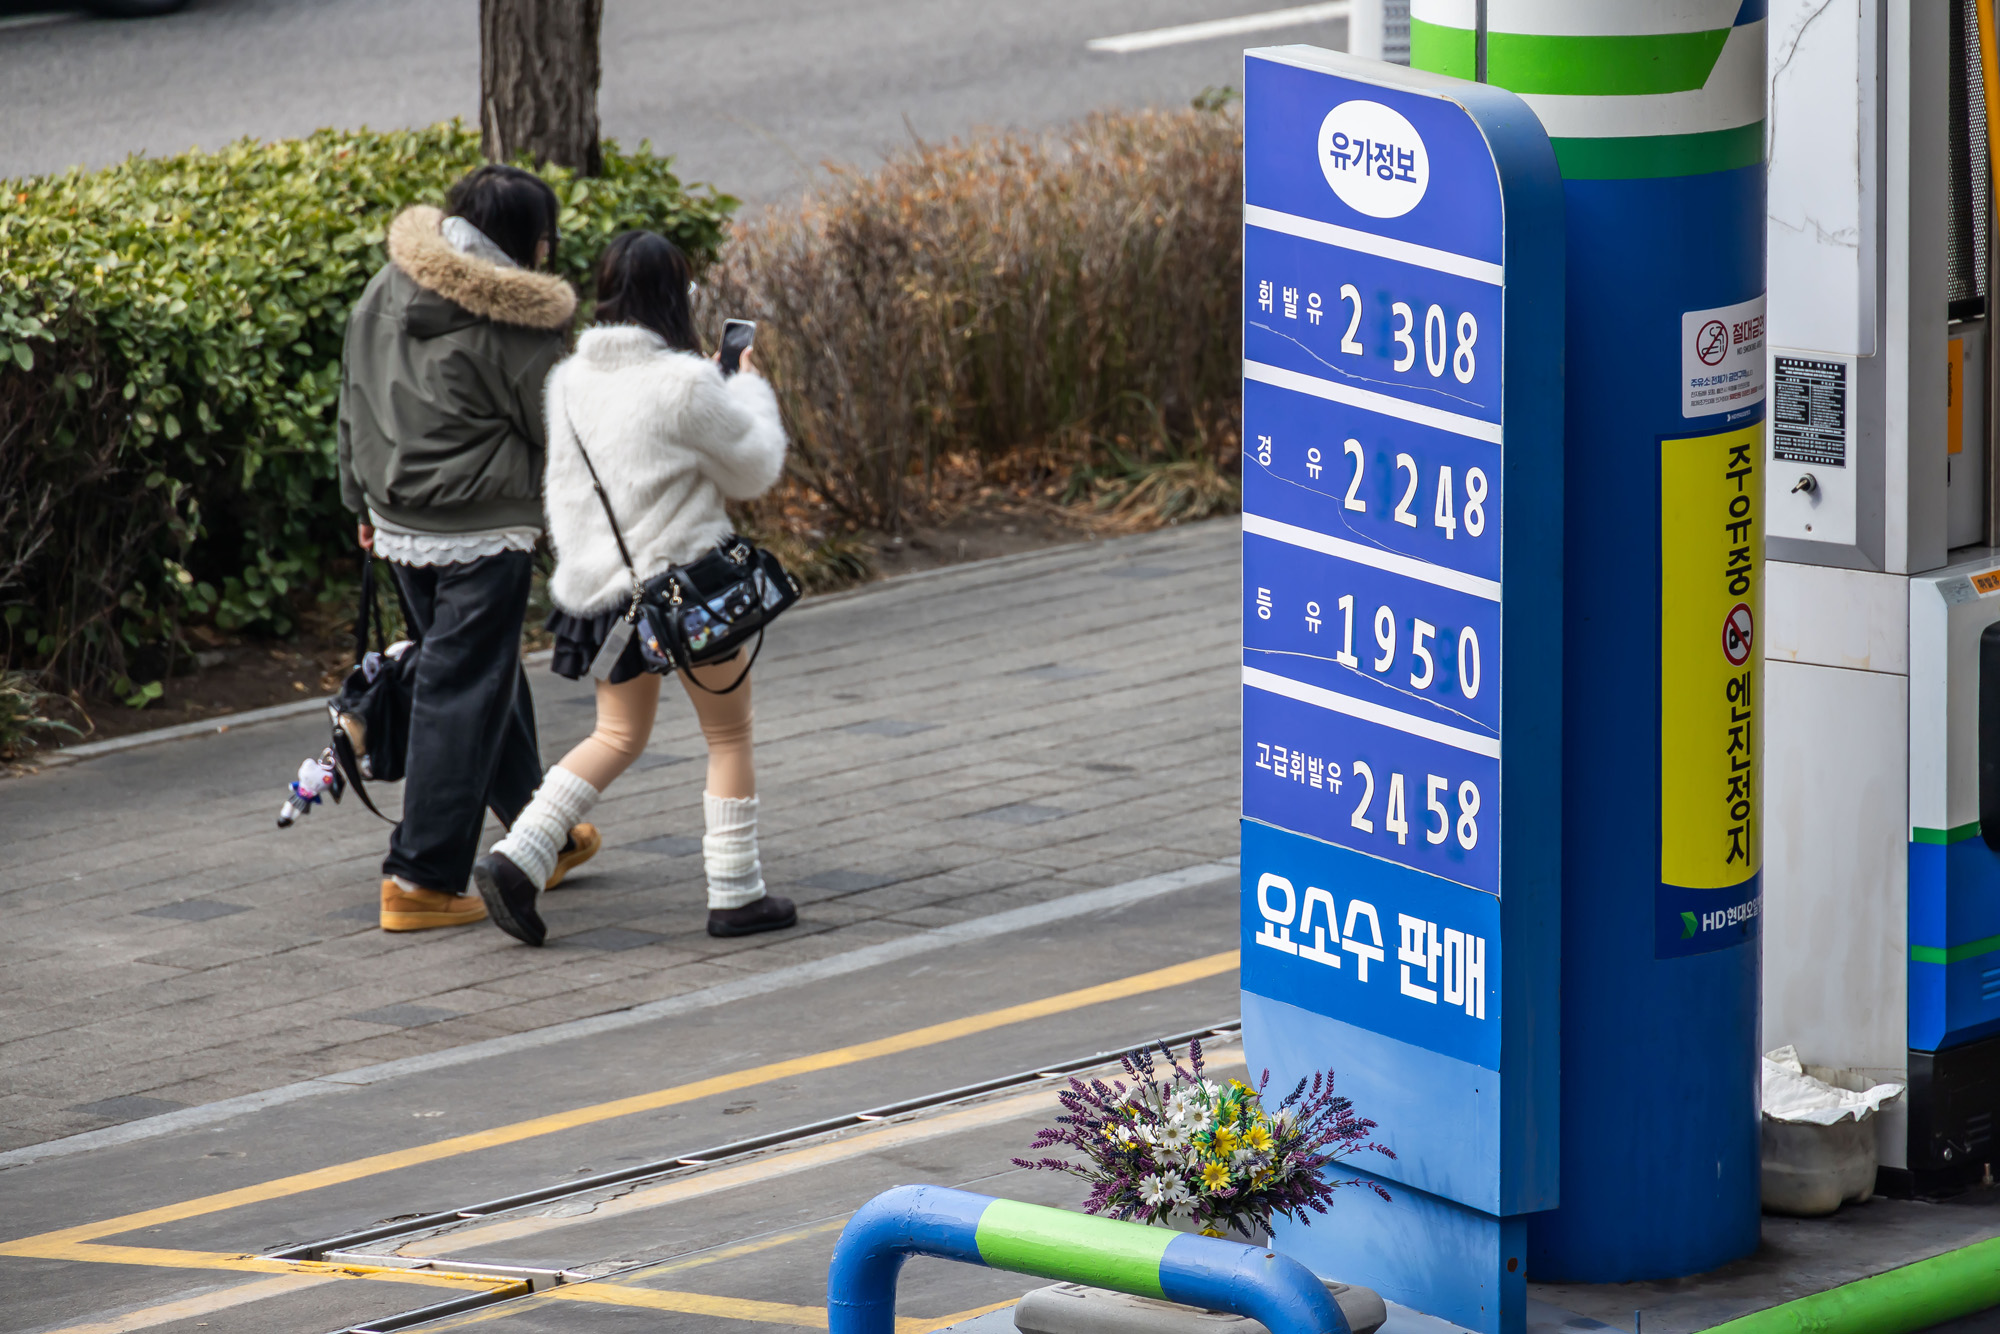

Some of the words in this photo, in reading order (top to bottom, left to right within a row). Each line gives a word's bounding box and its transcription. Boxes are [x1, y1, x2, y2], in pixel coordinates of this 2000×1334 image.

[1329, 131, 1418, 184] 유가정보
[1257, 279, 1324, 326] 휘발유
[1690, 376, 1711, 388] 주유소
[1343, 438, 1489, 540] 2248
[1726, 443, 1753, 596] 주유중
[1336, 594, 1481, 700] 1950
[1255, 741, 1343, 795] 고급휘발유
[1350, 760, 1481, 851] 2458
[1725, 671, 1751, 867] 엔진정지
[1255, 872, 1385, 983] 요소수
[1397, 912, 1486, 1021] 판매
[1702, 894, 1763, 932] HD현대오일
